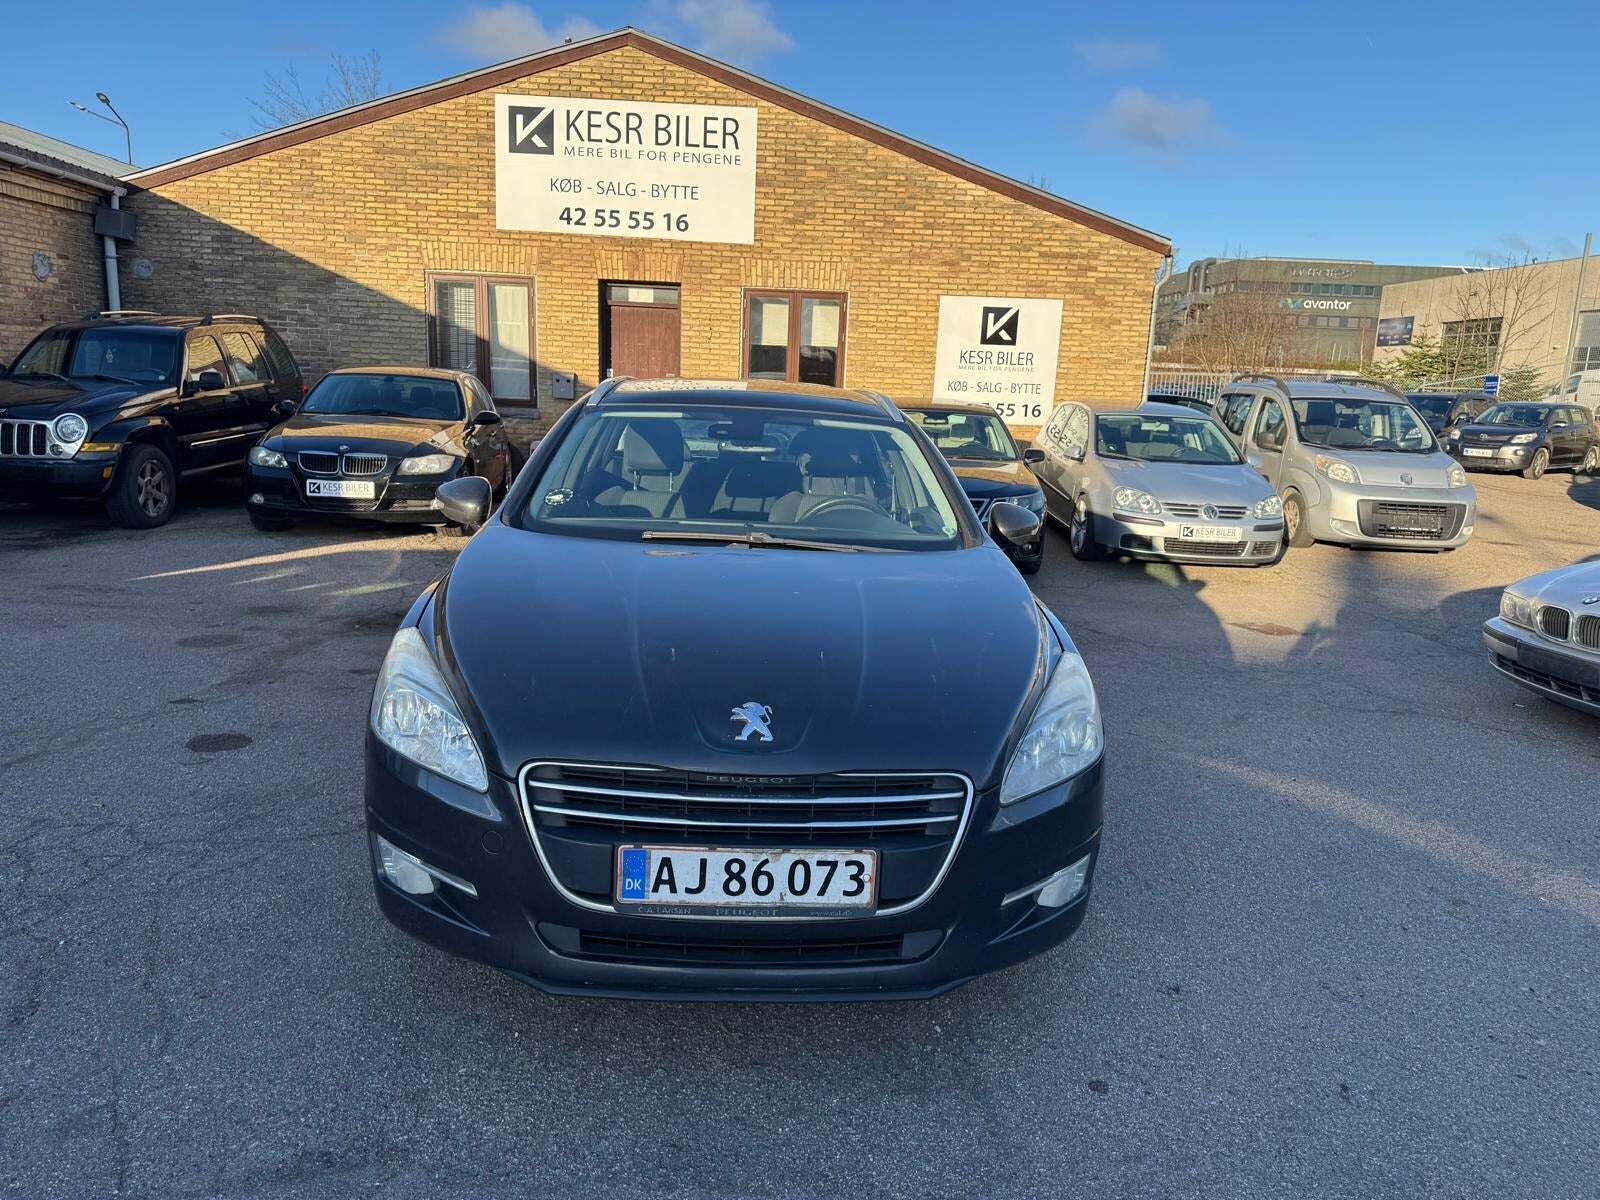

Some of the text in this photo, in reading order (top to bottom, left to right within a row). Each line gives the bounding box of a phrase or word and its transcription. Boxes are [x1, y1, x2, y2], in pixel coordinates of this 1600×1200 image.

[566, 109, 740, 150] KESR BILER
[563, 146, 742, 166] MERE BIL FOR PENGENE
[550, 177, 582, 194] KØB
[596, 180, 637, 197] SALG
[651, 183, 699, 201] BYTTE
[559, 207, 690, 232] 42 55 55 16
[1303, 299, 1352, 310] avantor
[960, 350, 1034, 366] KESR BILER
[947, 380, 968, 392] KØB
[976, 381, 1003, 393] SALG
[1010, 383, 1042, 395] BYTTE
[996, 403, 1016, 417] 55
[1022, 404, 1042, 418] 16
[322, 482, 344, 492] KESR
[1195, 527, 1237, 537] KESR BILER
[706, 775, 796, 784] PEUGEOT
[625, 878, 642, 891] DK
[651, 856, 867, 898] AJ 86 073
